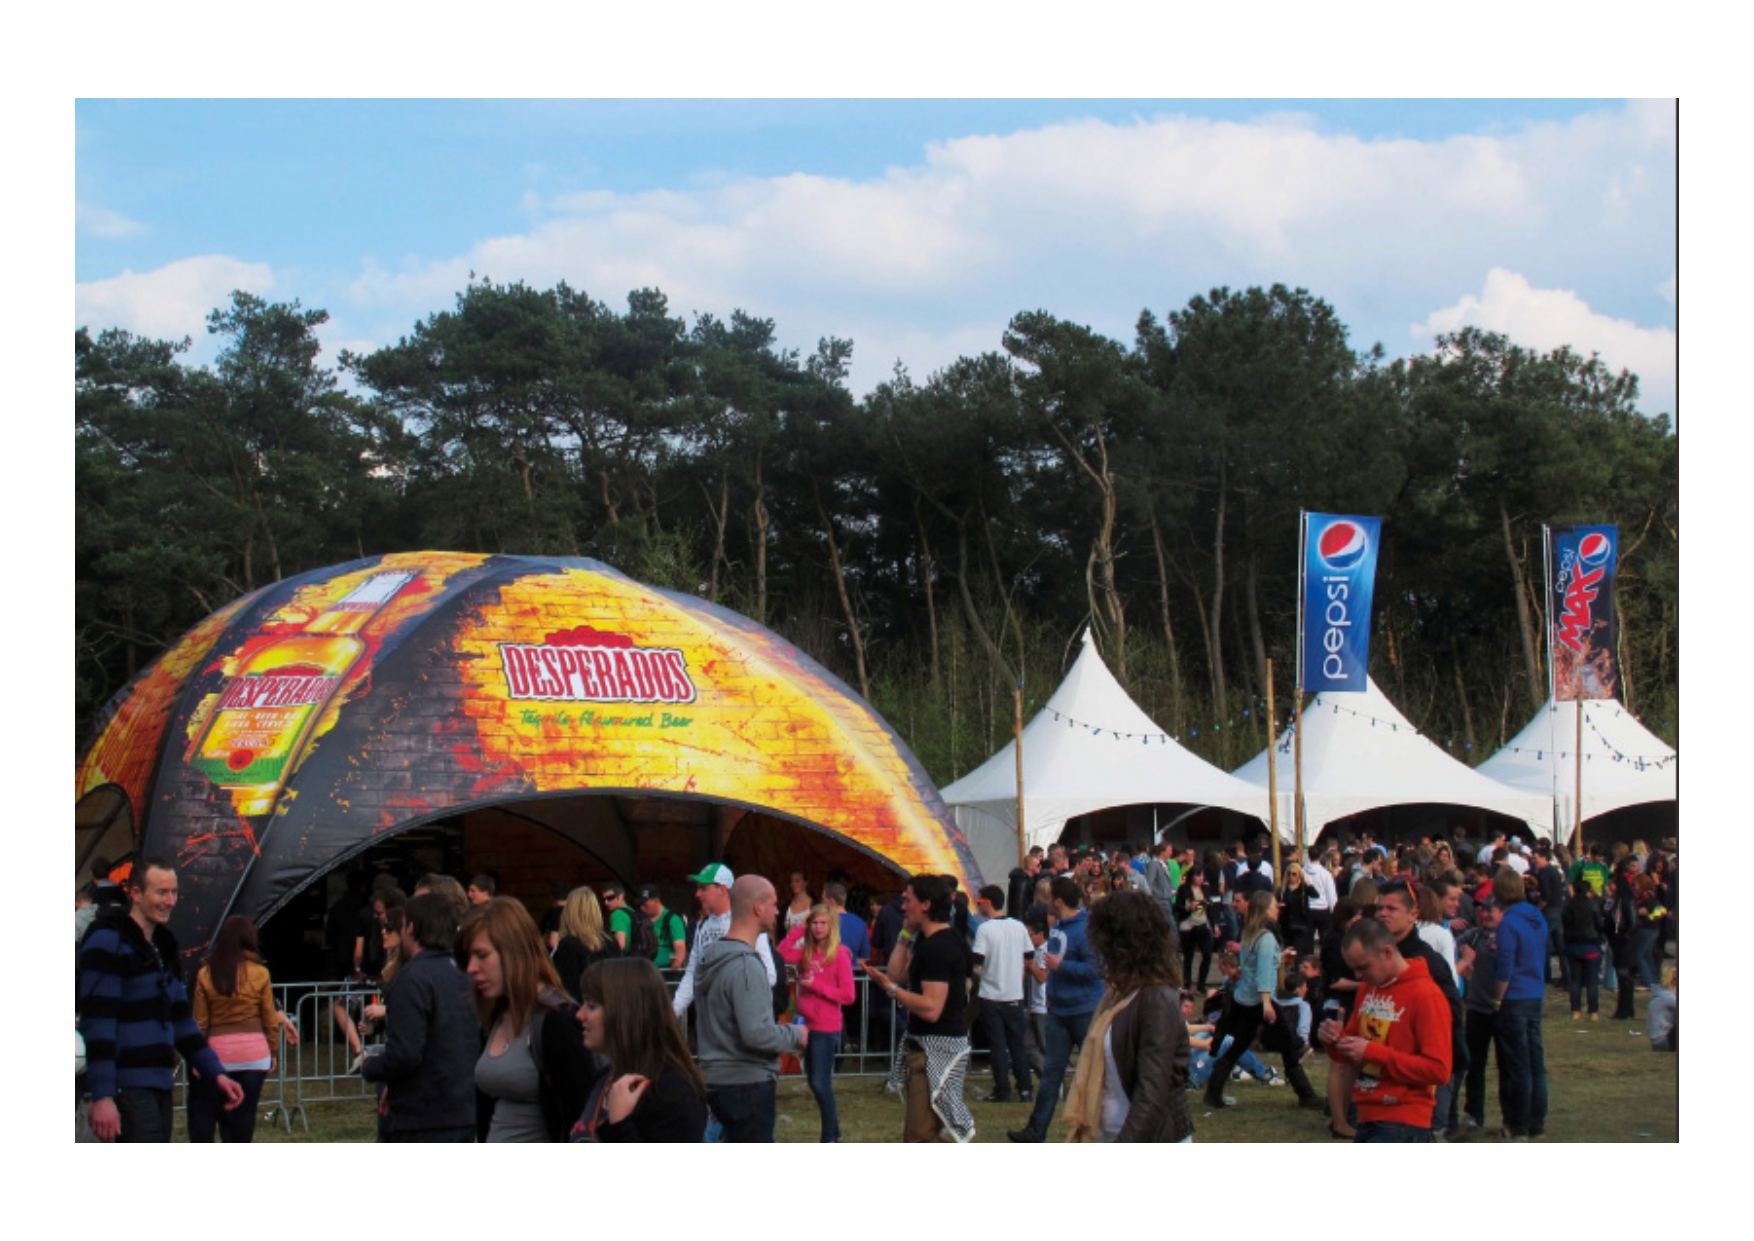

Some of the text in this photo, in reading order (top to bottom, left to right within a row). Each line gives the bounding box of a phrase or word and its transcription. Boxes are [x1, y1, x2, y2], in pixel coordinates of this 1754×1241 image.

[1555, 548, 1576, 594] pepsi
[1322, 576, 1352, 680] pepsi
[1557, 555, 1606, 654] MAX
[503, 646, 692, 701] DESPERADOS
[659, 712, 694, 729] Beer
